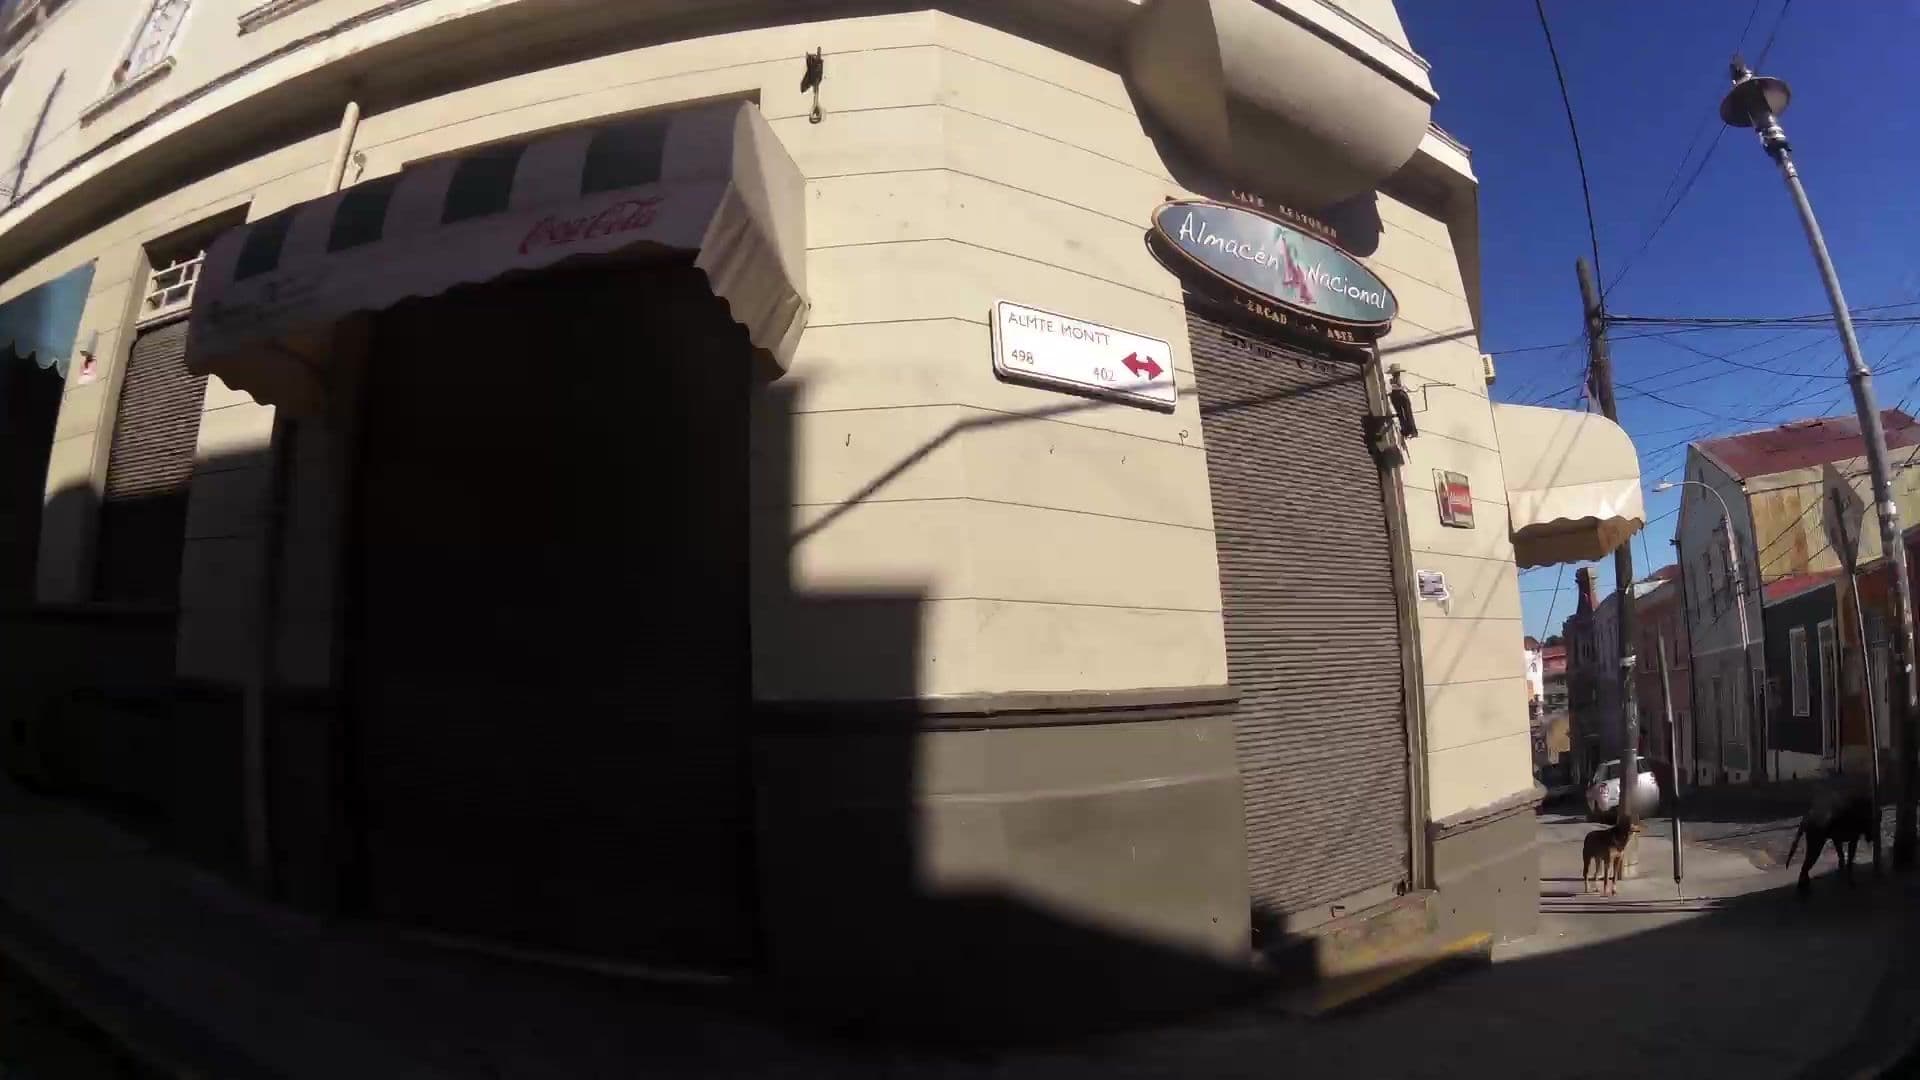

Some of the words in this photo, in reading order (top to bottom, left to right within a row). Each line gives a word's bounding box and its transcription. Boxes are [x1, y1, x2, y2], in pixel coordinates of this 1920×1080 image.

[1179, 211, 1280, 272] Almacén
[1302, 262, 1387, 309] Nacional
[1008, 311, 1054, 333] ALMTE
[1061, 322, 1111, 346] MONTT
[1011, 349, 1035, 365] 498
[1093, 367, 1117, 382] 402
